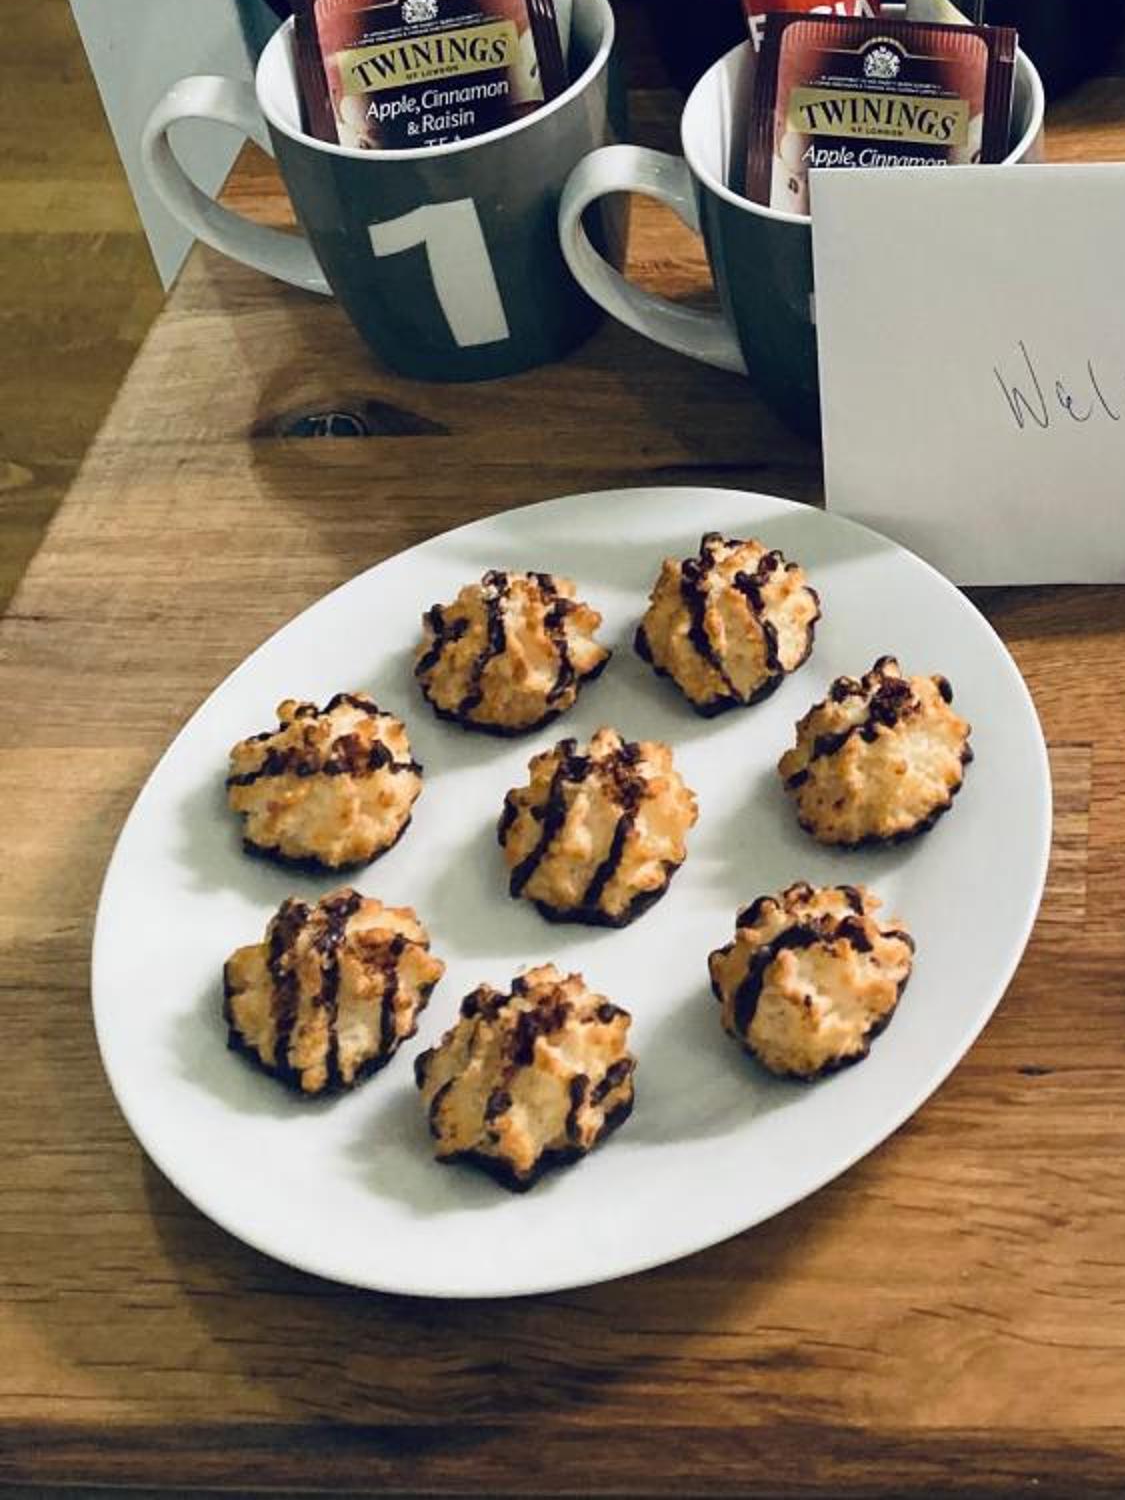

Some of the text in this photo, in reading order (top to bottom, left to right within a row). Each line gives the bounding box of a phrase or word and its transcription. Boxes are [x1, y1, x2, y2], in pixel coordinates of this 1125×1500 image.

[351, 35, 508, 87] TWININGS
[365, 79, 510, 123] Apple, Cinnamon
[407, 109, 476, 136] & Raisin
[800, 98, 957, 141] TWININGS
[801, 145, 856, 168] Apple,
[368, 197, 510, 347] 1
